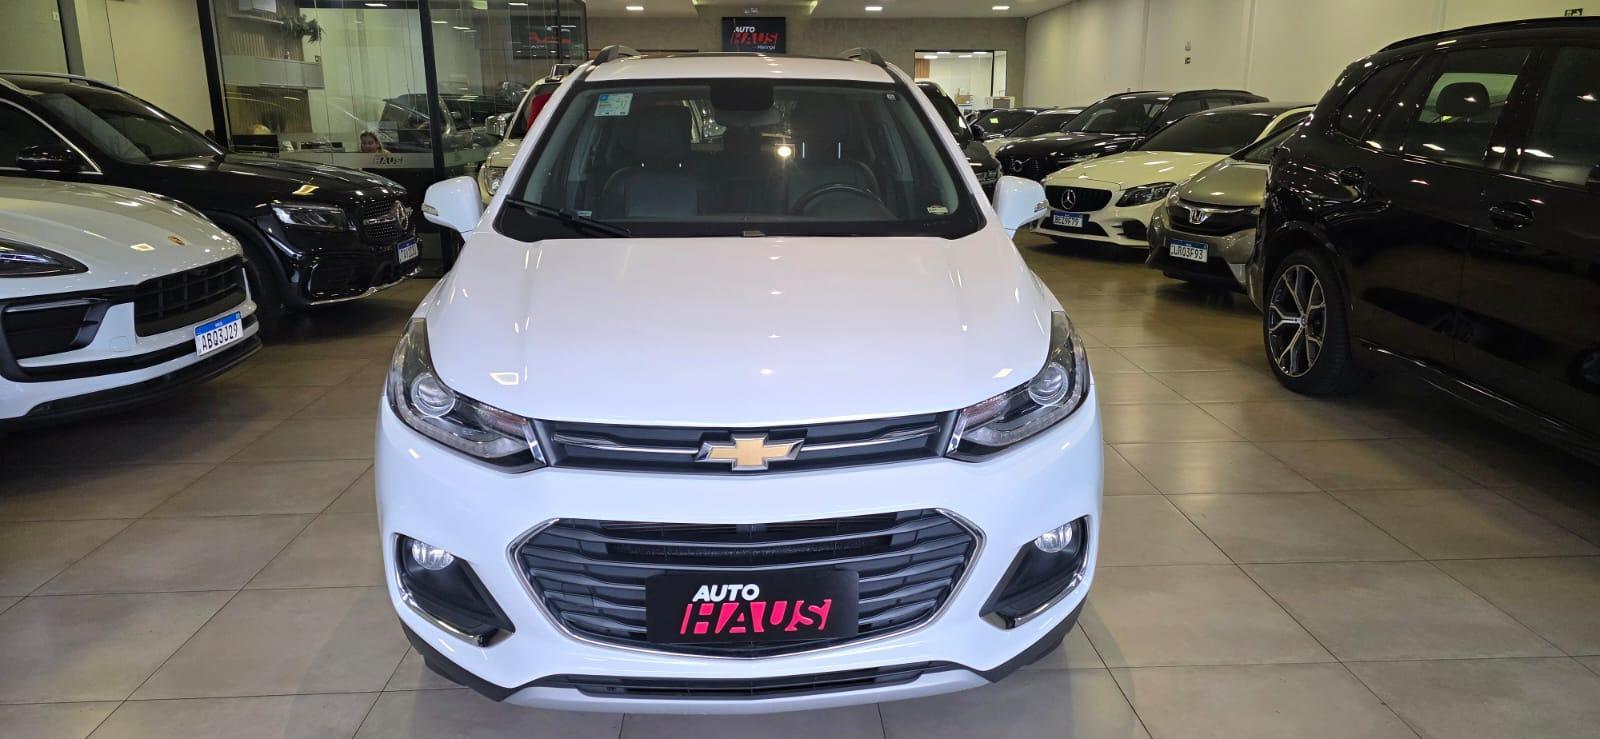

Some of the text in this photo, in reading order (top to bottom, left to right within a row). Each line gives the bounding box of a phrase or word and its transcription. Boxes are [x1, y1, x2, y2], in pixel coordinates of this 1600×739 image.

[730, 32, 780, 46] HAUS
[201, 322, 238, 351] ABQ3J29
[692, 584, 760, 602] AUTO
[680, 599, 832, 635] HAUS
